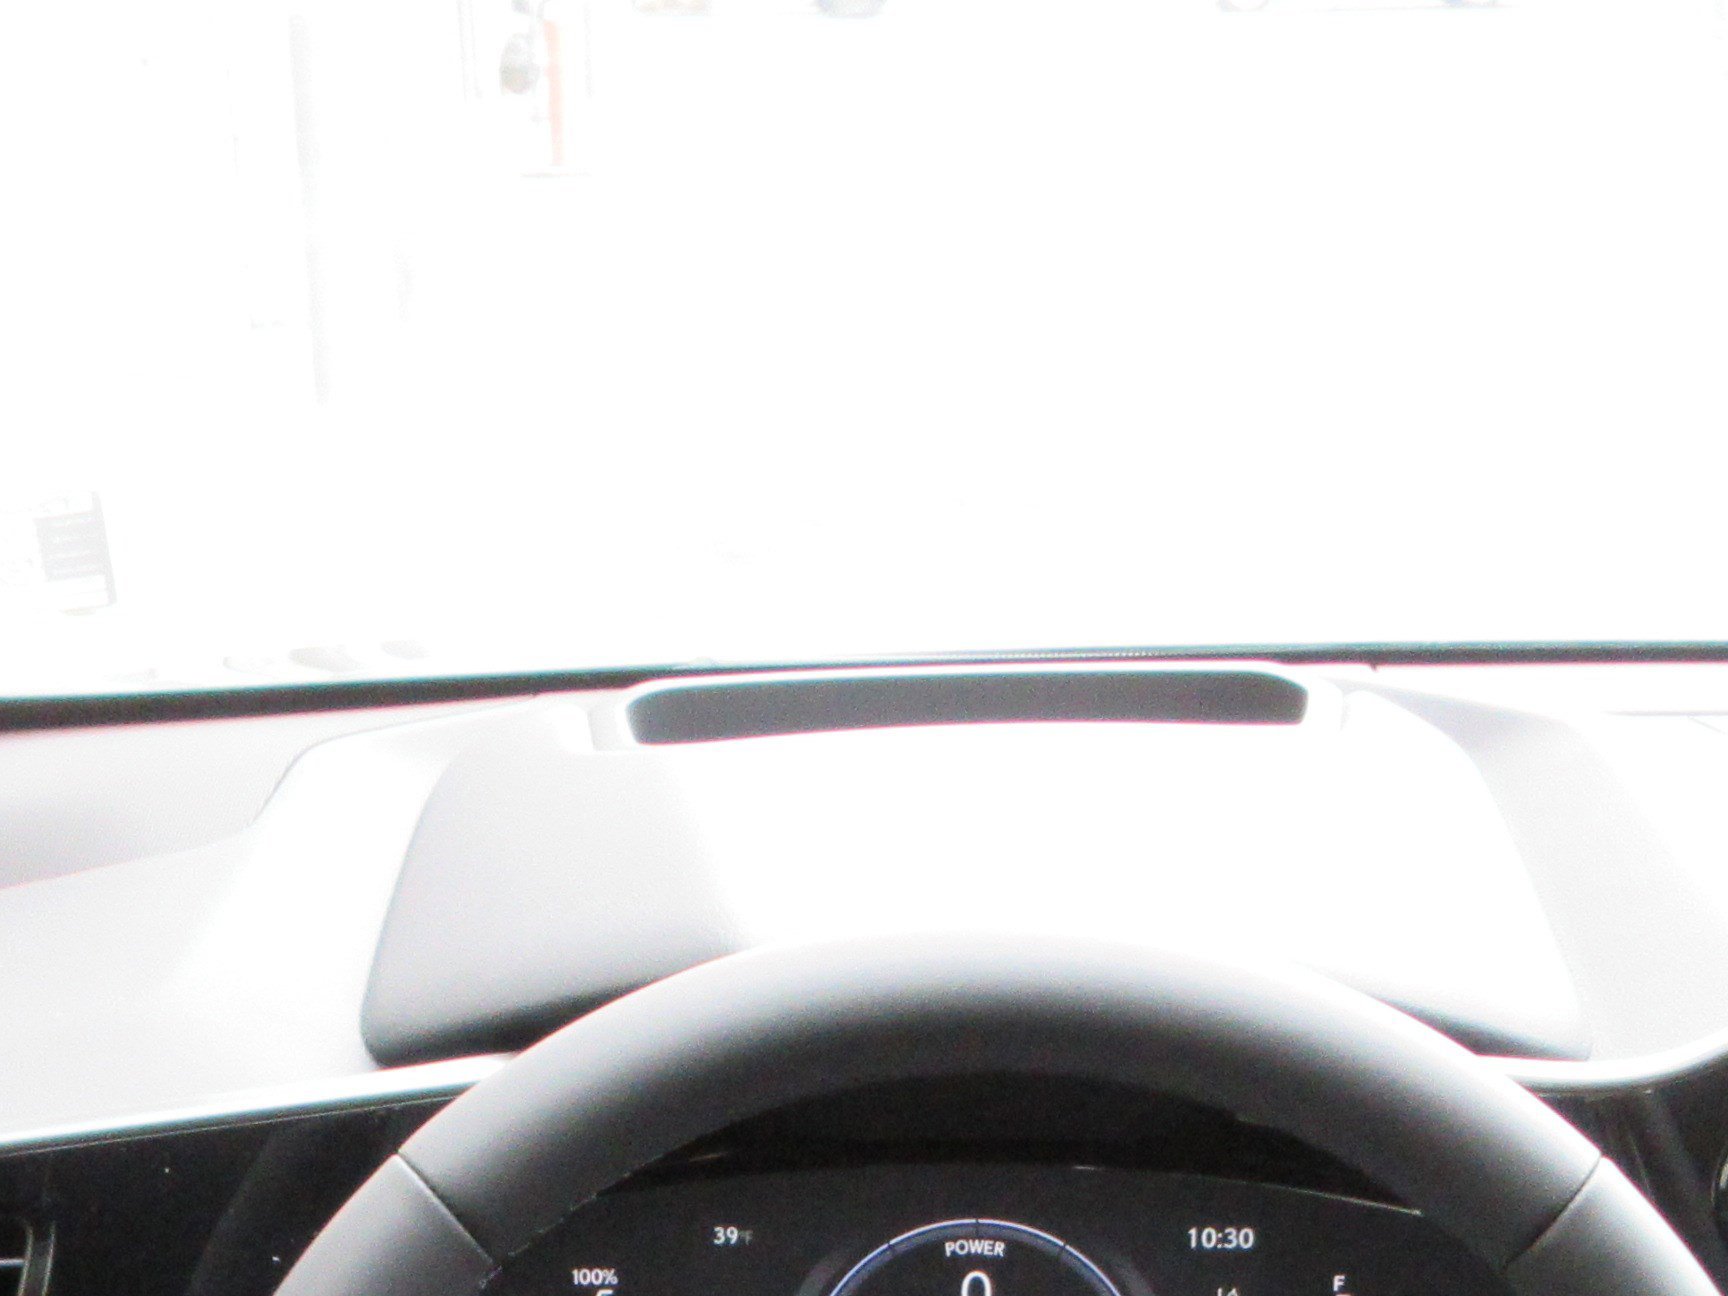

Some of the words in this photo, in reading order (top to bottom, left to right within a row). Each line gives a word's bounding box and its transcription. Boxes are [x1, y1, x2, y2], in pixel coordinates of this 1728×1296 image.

[1186, 1226, 1256, 1250] 10:30
[944, 1239, 1007, 1257] POWER
[571, 1267, 619, 1286] 100%
[1332, 1273, 1347, 1292] F
